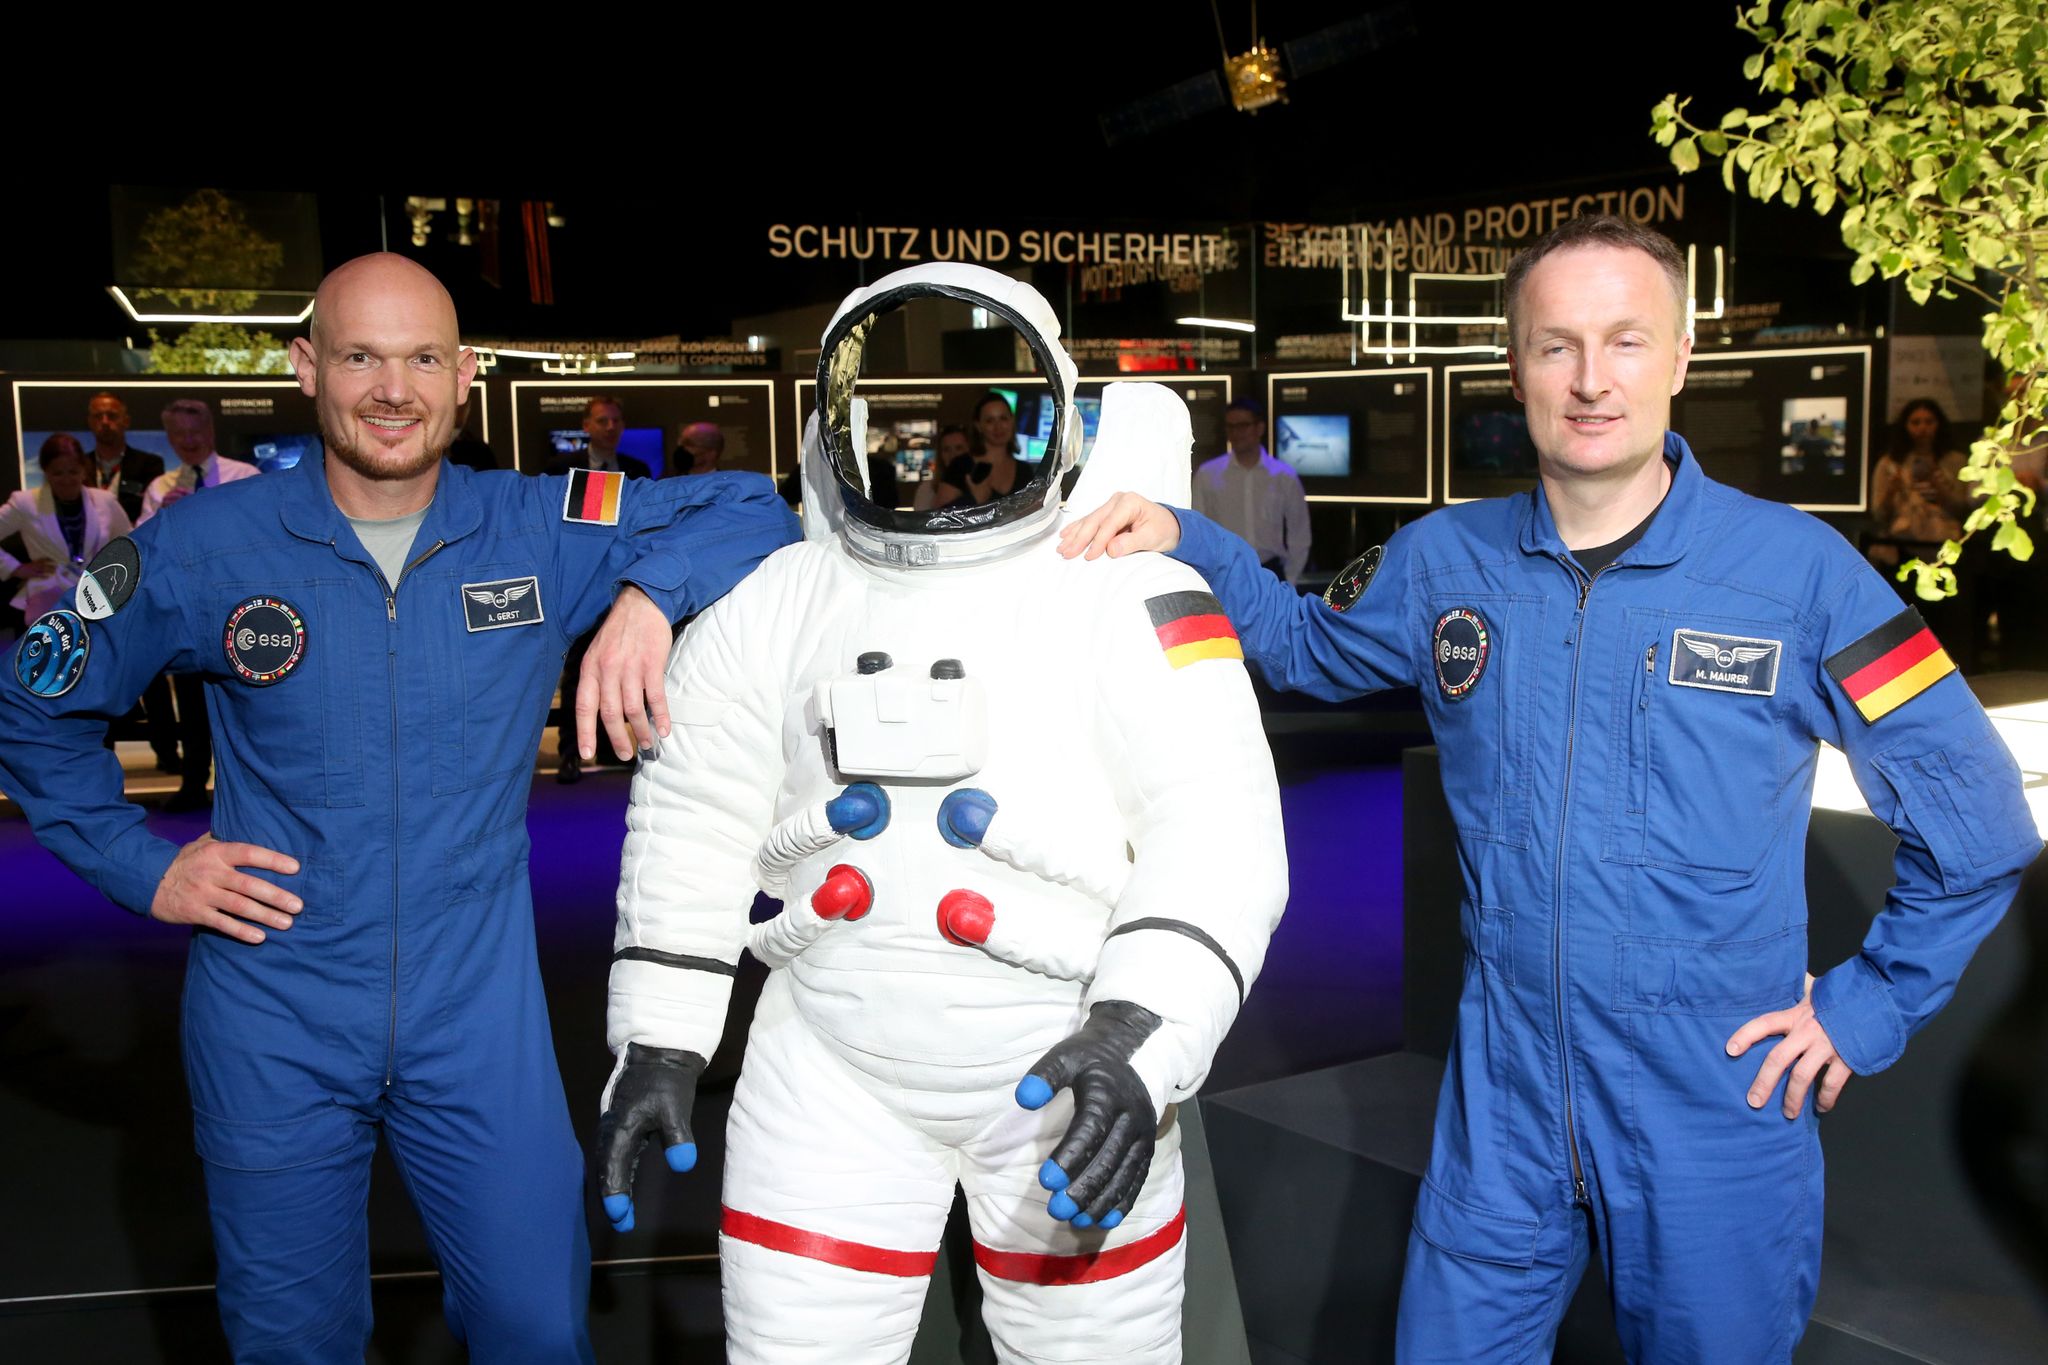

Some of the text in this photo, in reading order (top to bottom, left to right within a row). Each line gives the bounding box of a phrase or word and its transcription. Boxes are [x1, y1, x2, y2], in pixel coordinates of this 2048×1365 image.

[1392, 213, 1455, 248] AND
[768, 224, 1221, 265] SCHUTZ UND SICHERHEIT
[488, 610, 520, 622] A. GERST
[48, 615, 72, 652] blue dot
[259, 634, 292, 648] esa
[1452, 645, 1477, 661] esa
[1696, 669, 1749, 685] M. MAURER
